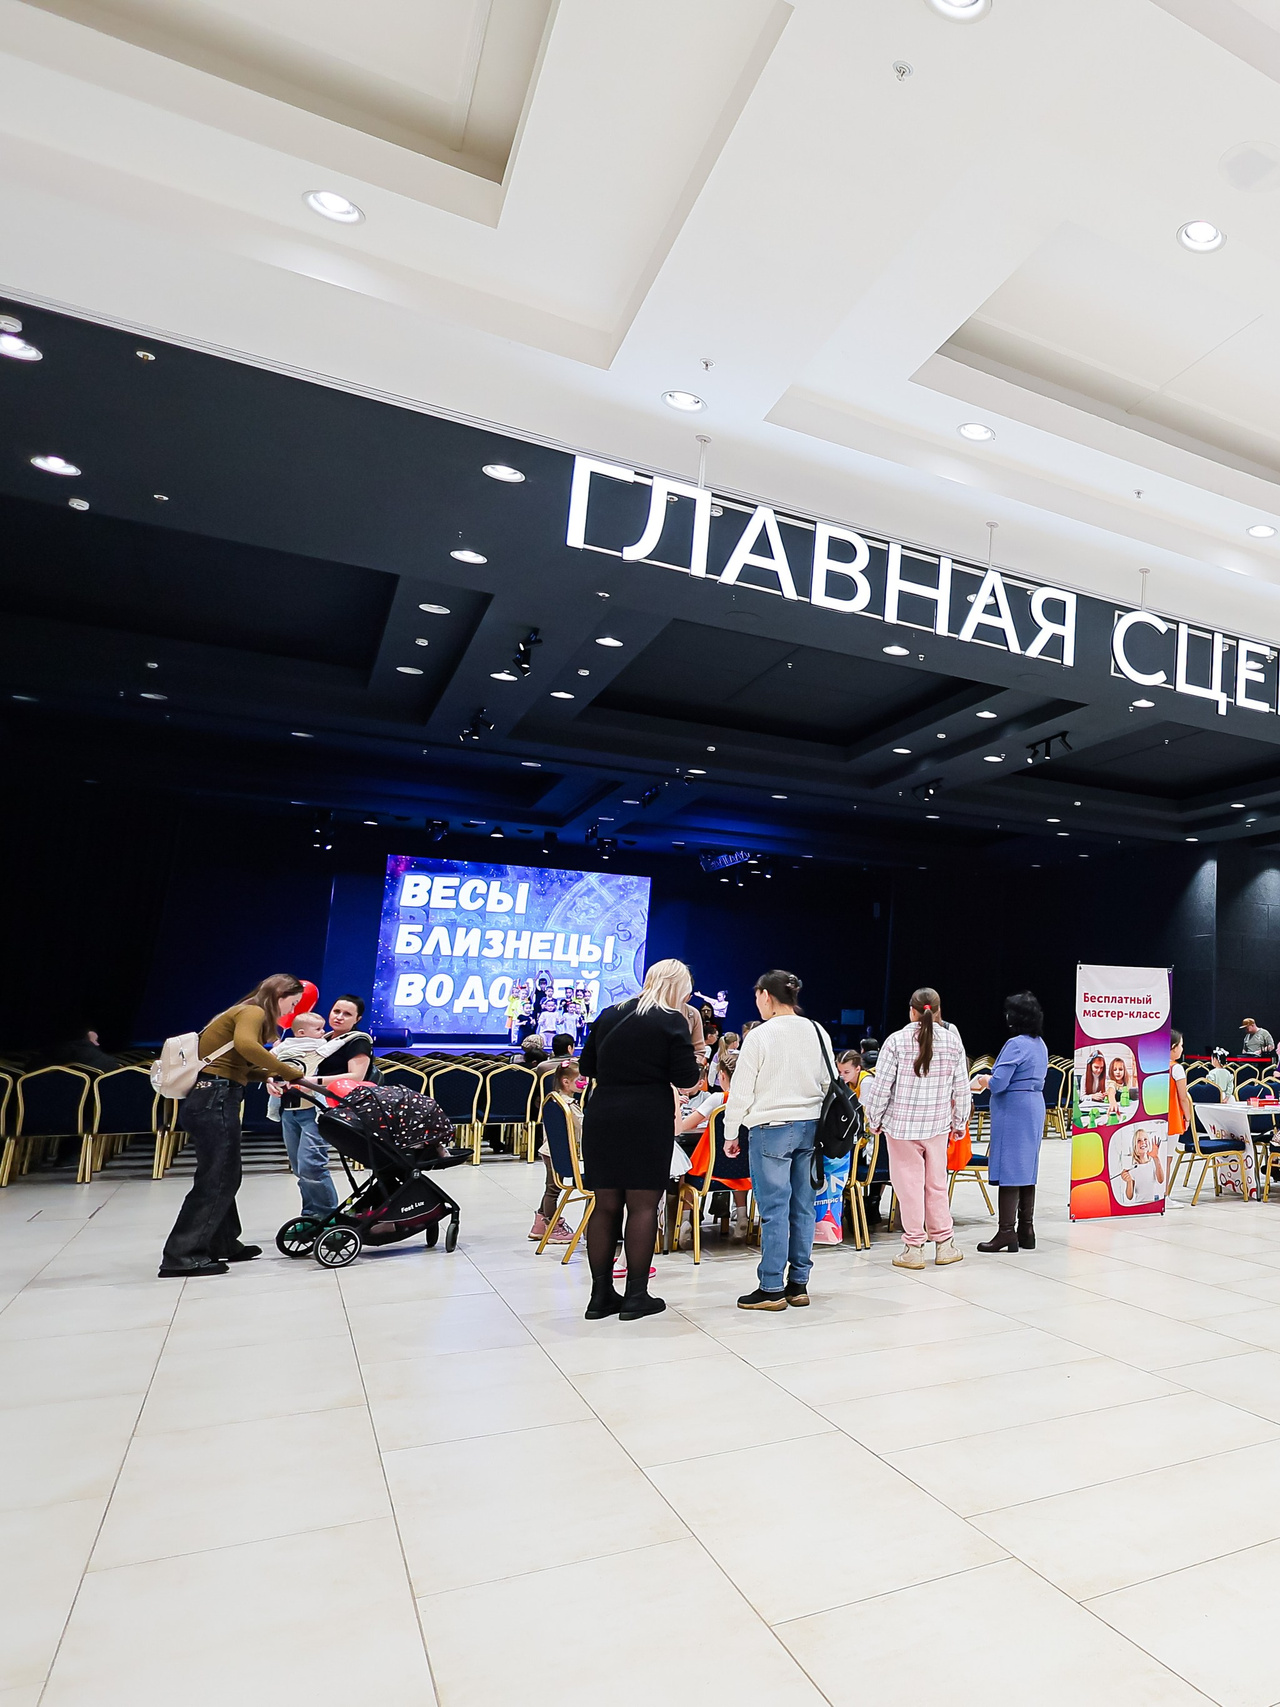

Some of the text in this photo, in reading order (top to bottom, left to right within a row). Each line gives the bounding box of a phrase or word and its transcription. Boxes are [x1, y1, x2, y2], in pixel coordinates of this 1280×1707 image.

[565, 455, 1079, 669] ГЛАВНАЯ
[399, 874, 530, 914] ВЕСЫ
[394, 923, 615, 968] БЛИЗНЕЦЫ
[393, 970, 601, 1014] ВОДОЕЙ
[1083, 992, 1152, 1005] Бесплатный
[1083, 1009, 1161, 1021] мастер-класс
